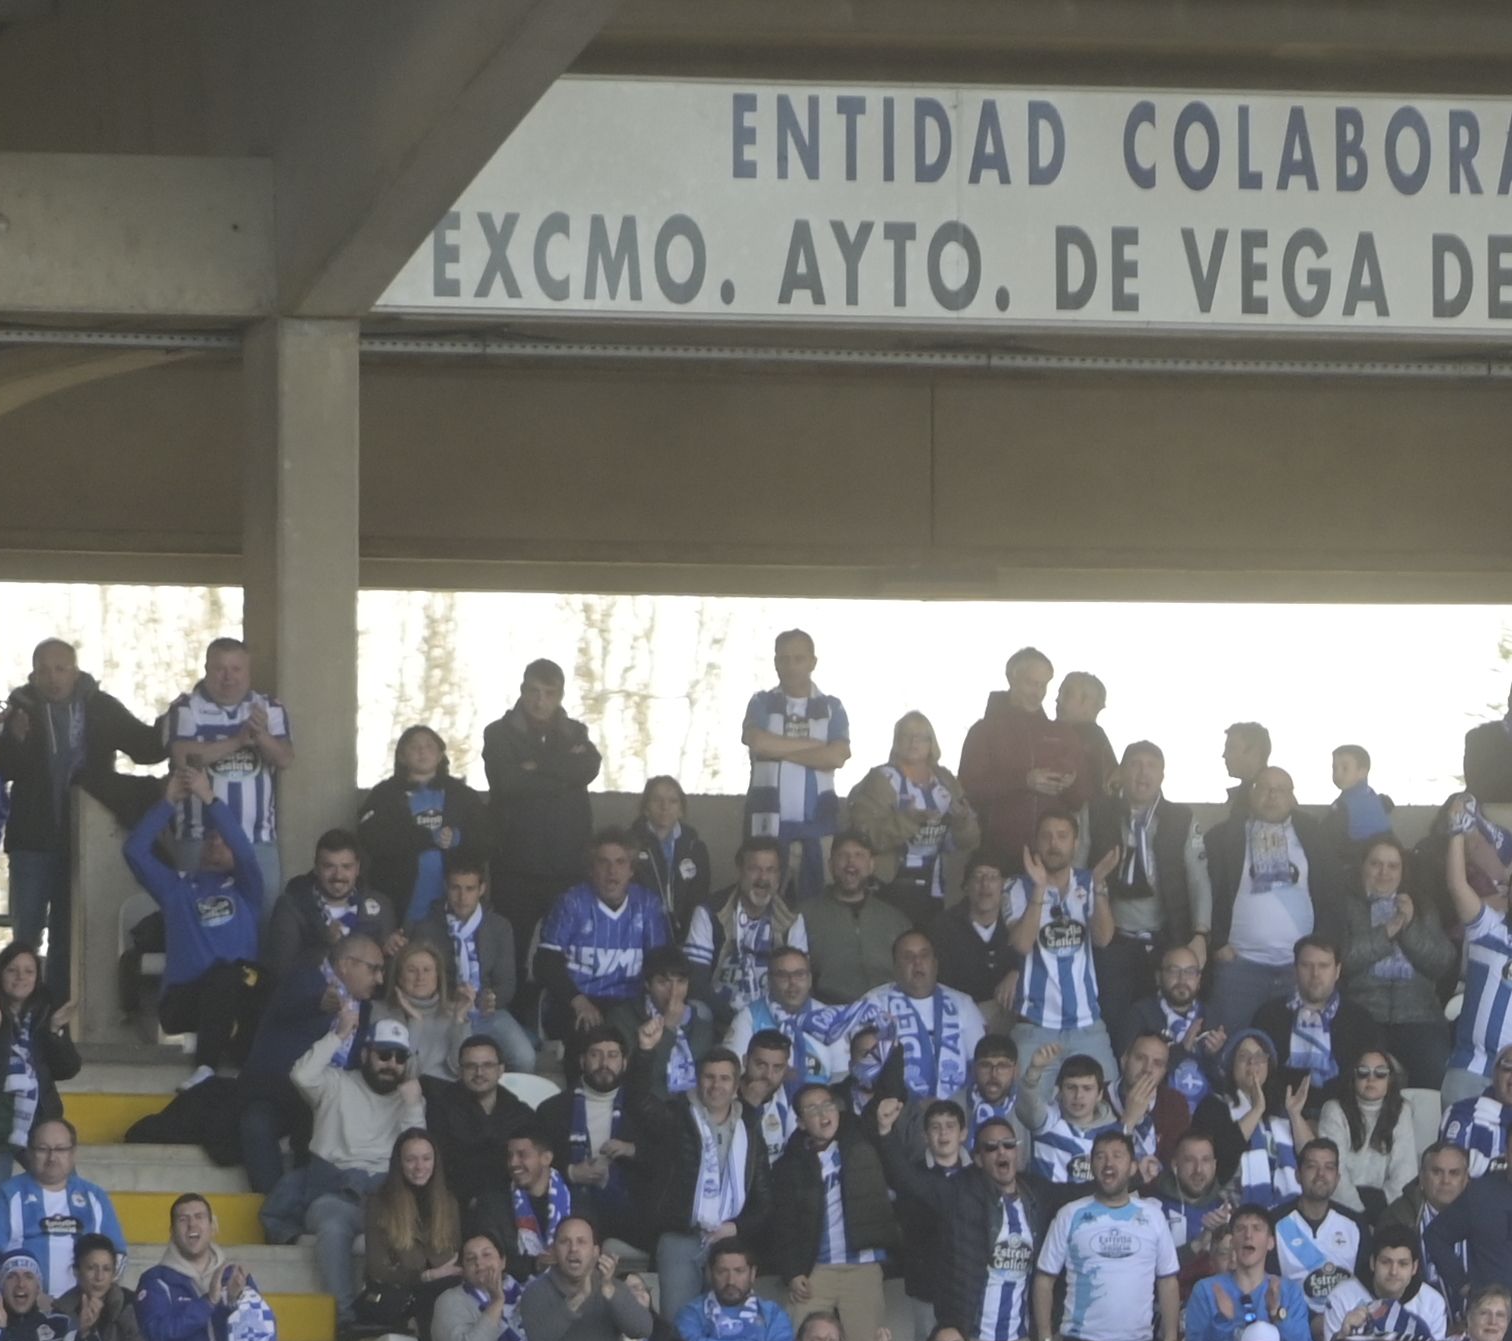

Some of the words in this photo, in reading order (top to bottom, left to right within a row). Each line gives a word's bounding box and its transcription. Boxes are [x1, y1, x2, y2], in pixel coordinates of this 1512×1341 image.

[732, 91, 1065, 188] ENTIDAD
[432, 208, 736, 305] EXCMO.
[777, 219, 1010, 316] AYTO.
[1054, 223, 1143, 316] DE
[1182, 227, 1393, 322] VEGA
